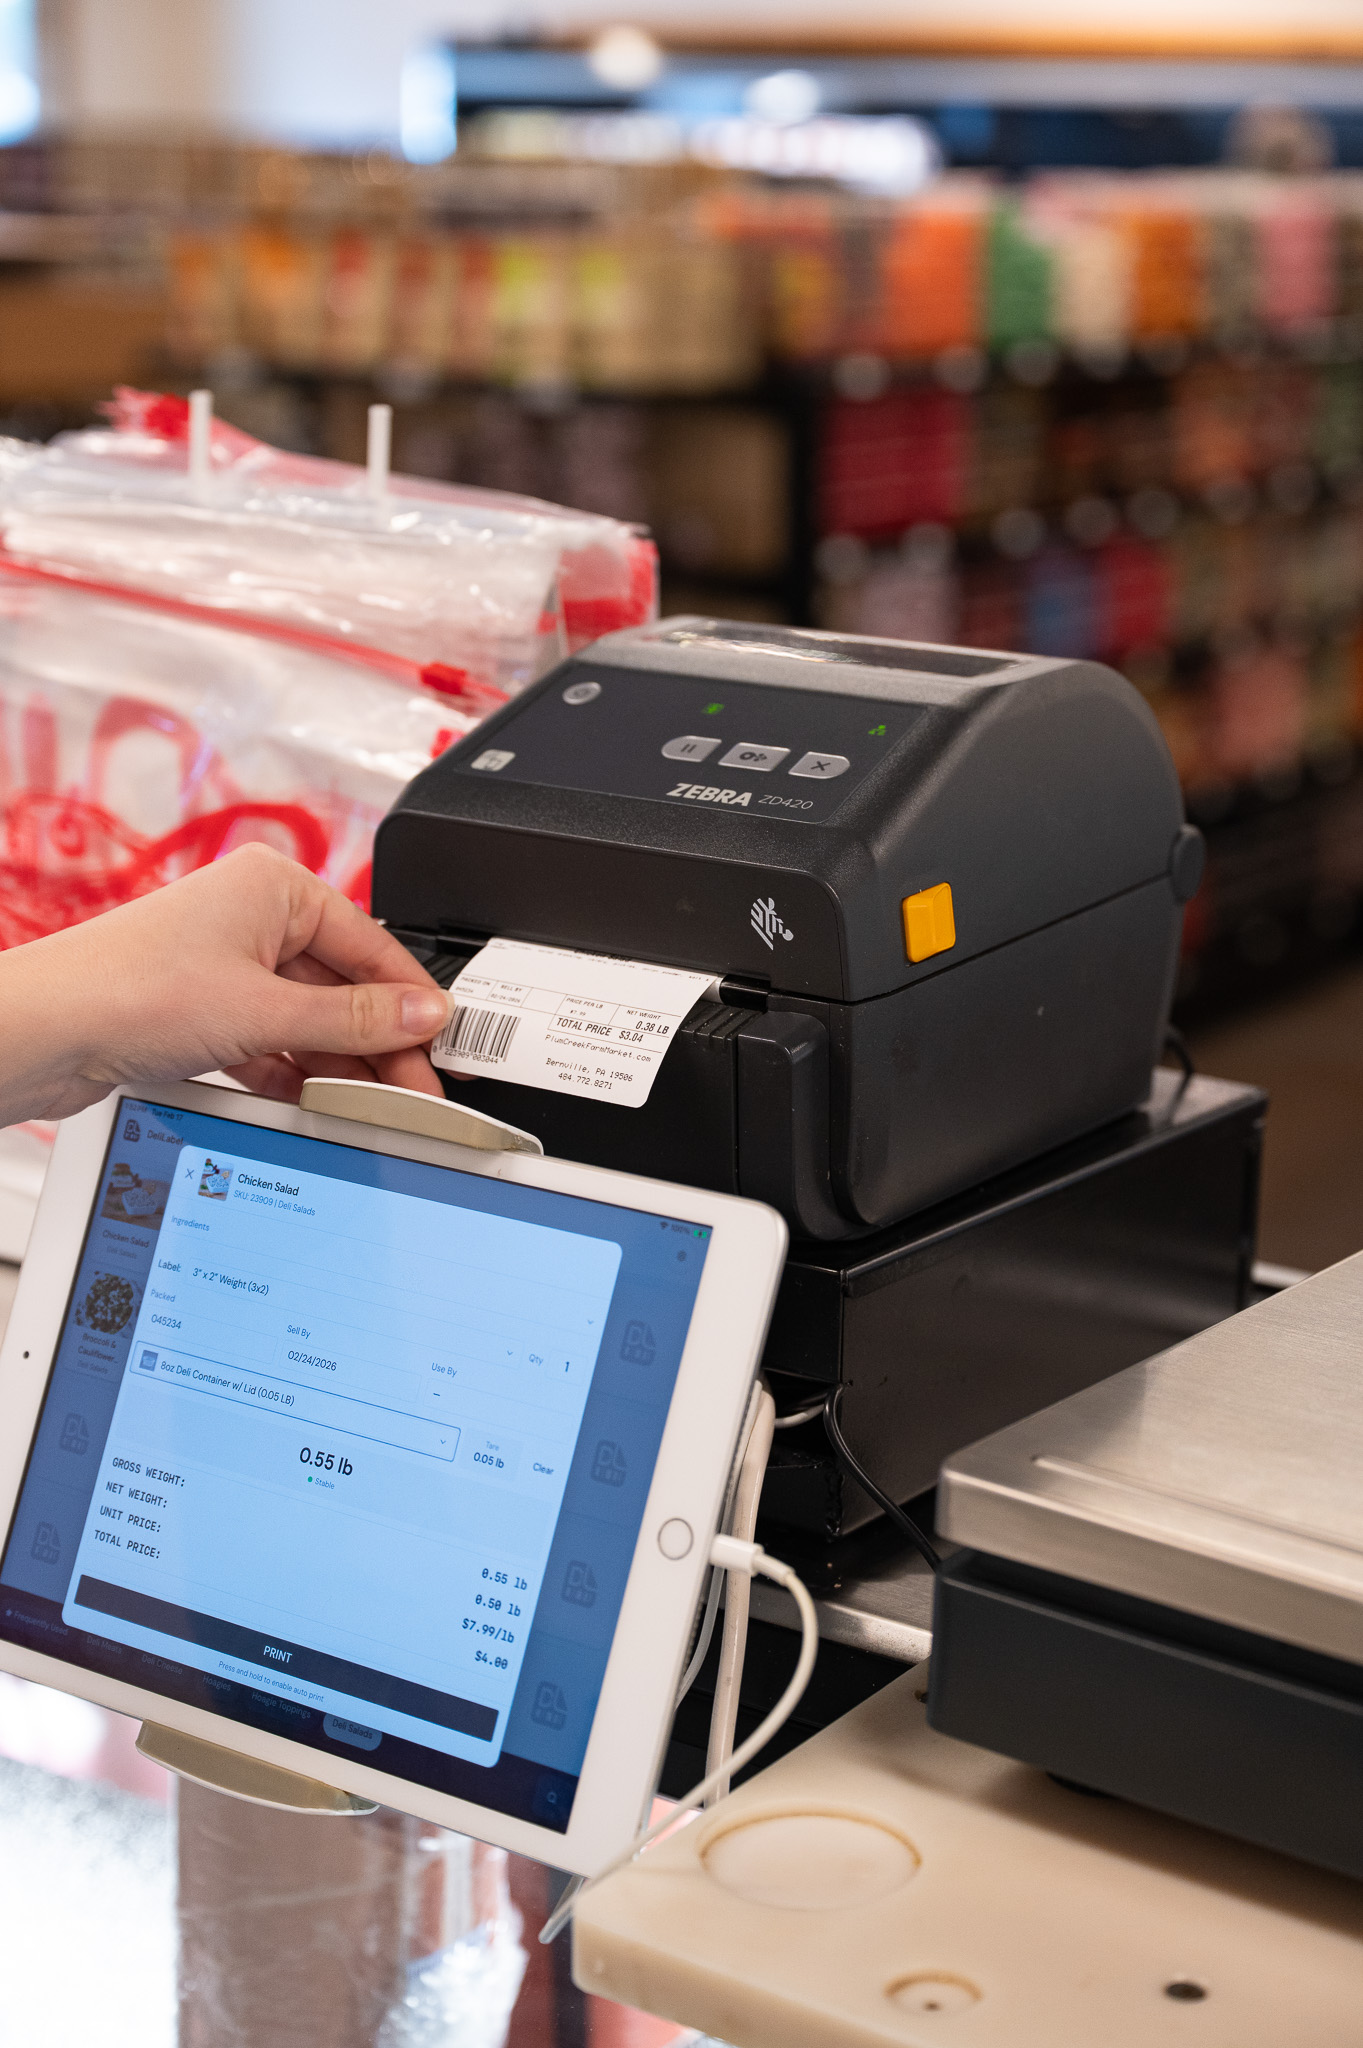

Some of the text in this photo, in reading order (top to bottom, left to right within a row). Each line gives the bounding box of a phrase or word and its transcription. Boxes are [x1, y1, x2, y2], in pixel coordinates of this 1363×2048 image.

[666, 783, 814, 810] ZEBRA ZD420
[566, 998, 582, 1006] PRICE
[639, 1012, 661, 1020] WEIGHT
[556, 1018, 644, 1043] TOTAL PRICE $3.04
[636, 1020, 670, 1034] 0.38 LB
[444, 1048, 470, 1060] 223909
[472, 1053, 498, 1064] 003044
[545, 1034, 652, 1062] PlumCreekFarmMarket.com
[546, 1058, 633, 1082] Bernville, PA 19506
[558, 1072, 613, 1090] 484.772.8271
[152, 1108, 162, 1116] Tue
[164, 1111, 175, 1120] Feb
[146, 1130, 184, 1145] DeliLabel
[238, 1173, 300, 1196] Chicken Salad
[233, 1189, 250, 1201] SKU:
[250, 1194, 274, 1207] 23909
[278, 1200, 291, 1211] Deli
[292, 1204, 316, 1216] Salads
[171, 1215, 210, 1232] Ingredients
[102, 1230, 150, 1248] Chicken Salad
[158, 1258, 181, 1272] Label:
[203, 1272, 208, 1280] x
[220, 1274, 246, 1290] Weight
[248, 1280, 270, 1296] (3x2)
[151, 1288, 176, 1302] Packed
[151, 1314, 182, 1330] 045234
[286, 1324, 311, 1338] Sell By
[287, 1350, 338, 1372] 02/24/2026
[431, 1362, 458, 1378] Use By
[528, 1354, 570, 1372] Qty 1
[160, 1361, 296, 1407] 8oz Deli Container w/ Lid (0.05 LB)
[486, 1440, 499, 1451] Tare
[299, 1446, 354, 1476] 0.55 lb
[474, 1452, 504, 1468] 0.05 lb
[532, 1462, 554, 1476] Clear
[112, 1457, 185, 1488] GROSS WEIGHT:
[314, 1477, 335, 1490] Stable
[106, 1481, 168, 1508] NET WEIGHT:
[100, 1505, 162, 1533] UNIT PRICE:
[94, 1530, 160, 1559] TOTAL PRICE:
[481, 1568, 528, 1590] 0.55 lb
[475, 1594, 521, 1617] 0.50 lb
[14, 1610, 68, 1636] Frequently Used
[462, 1618, 515, 1644] $7.99/lb
[86, 1635, 122, 1655] Deli Meats
[263, 1645, 292, 1664] PRINT
[142, 1654, 182, 1674] Deli Cheese
[474, 1650, 508, 1670] $4.00
[202, 1674, 232, 1692] Hoagies
[218, 1660, 324, 1703] Press and hold to enable auto print
[252, 1690, 312, 1719] Hoagie Toppings
[332, 1718, 372, 1740] Deli Salads
